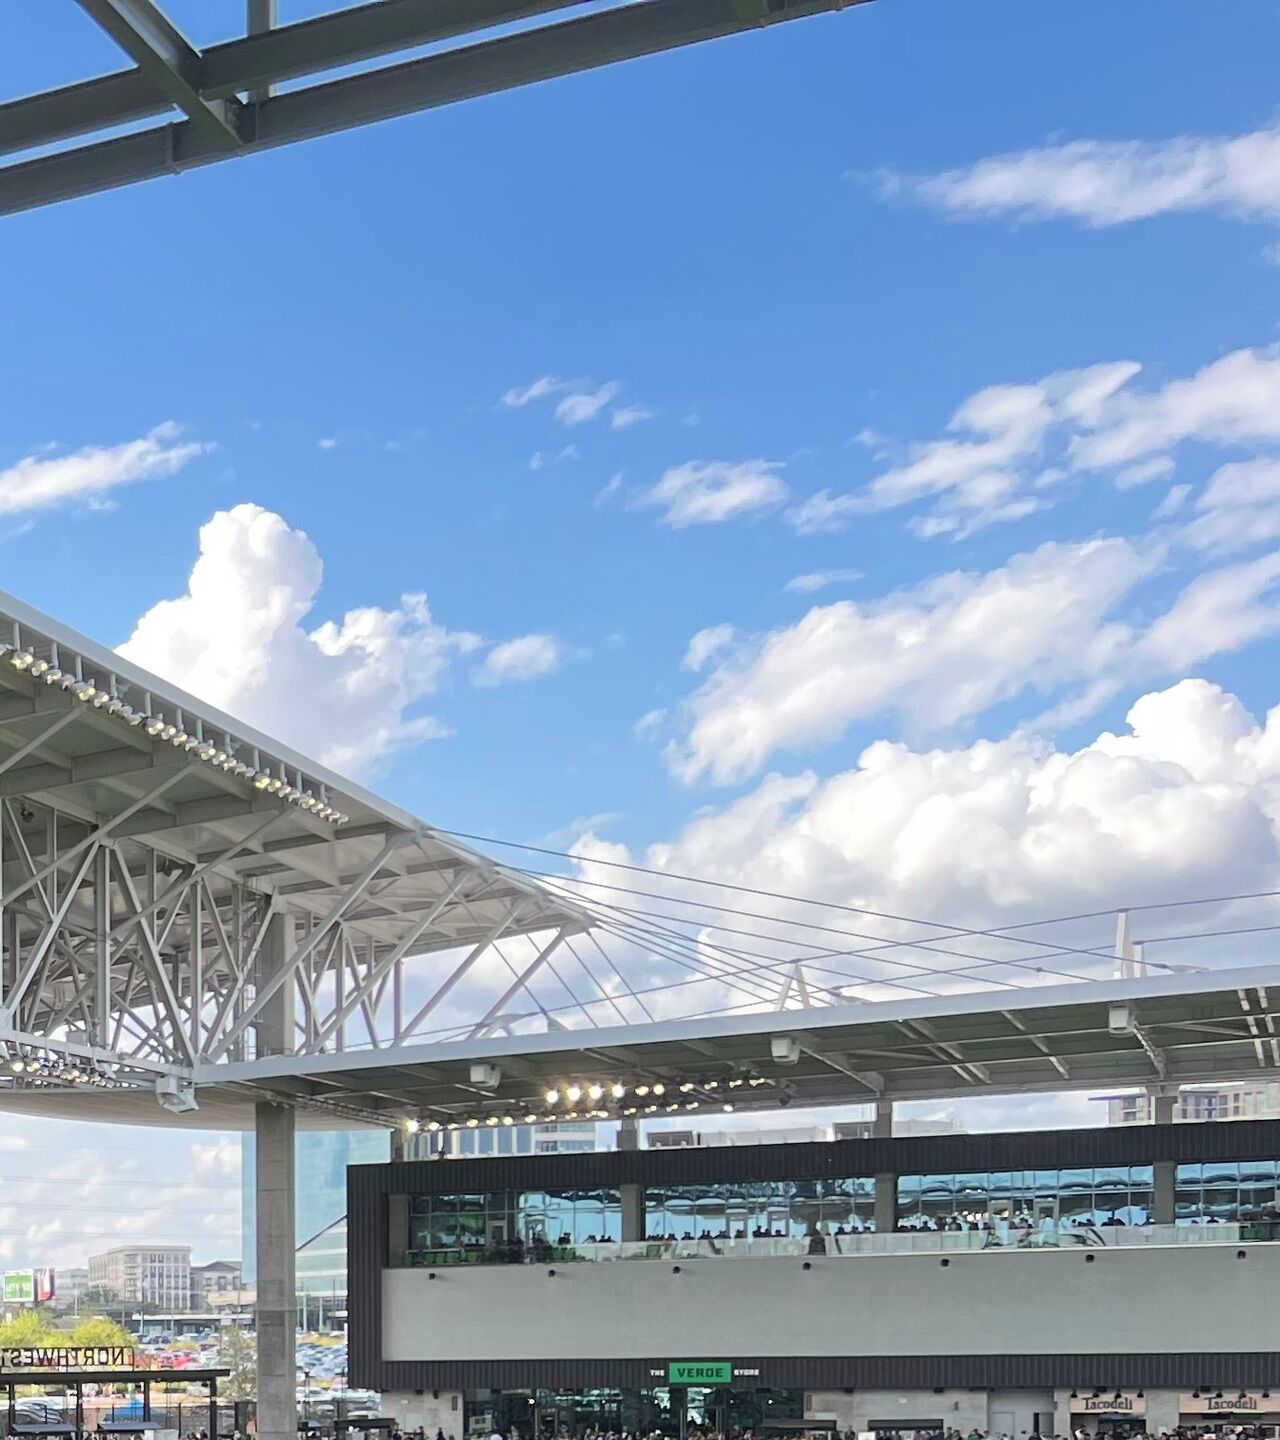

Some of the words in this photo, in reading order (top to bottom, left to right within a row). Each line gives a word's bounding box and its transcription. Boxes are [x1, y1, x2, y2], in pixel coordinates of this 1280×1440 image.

[677, 1367, 724, 1379] VERDE
[1082, 1397, 1133, 1411] Tacodeli
[1204, 1396, 1257, 1411] Tacodeli
